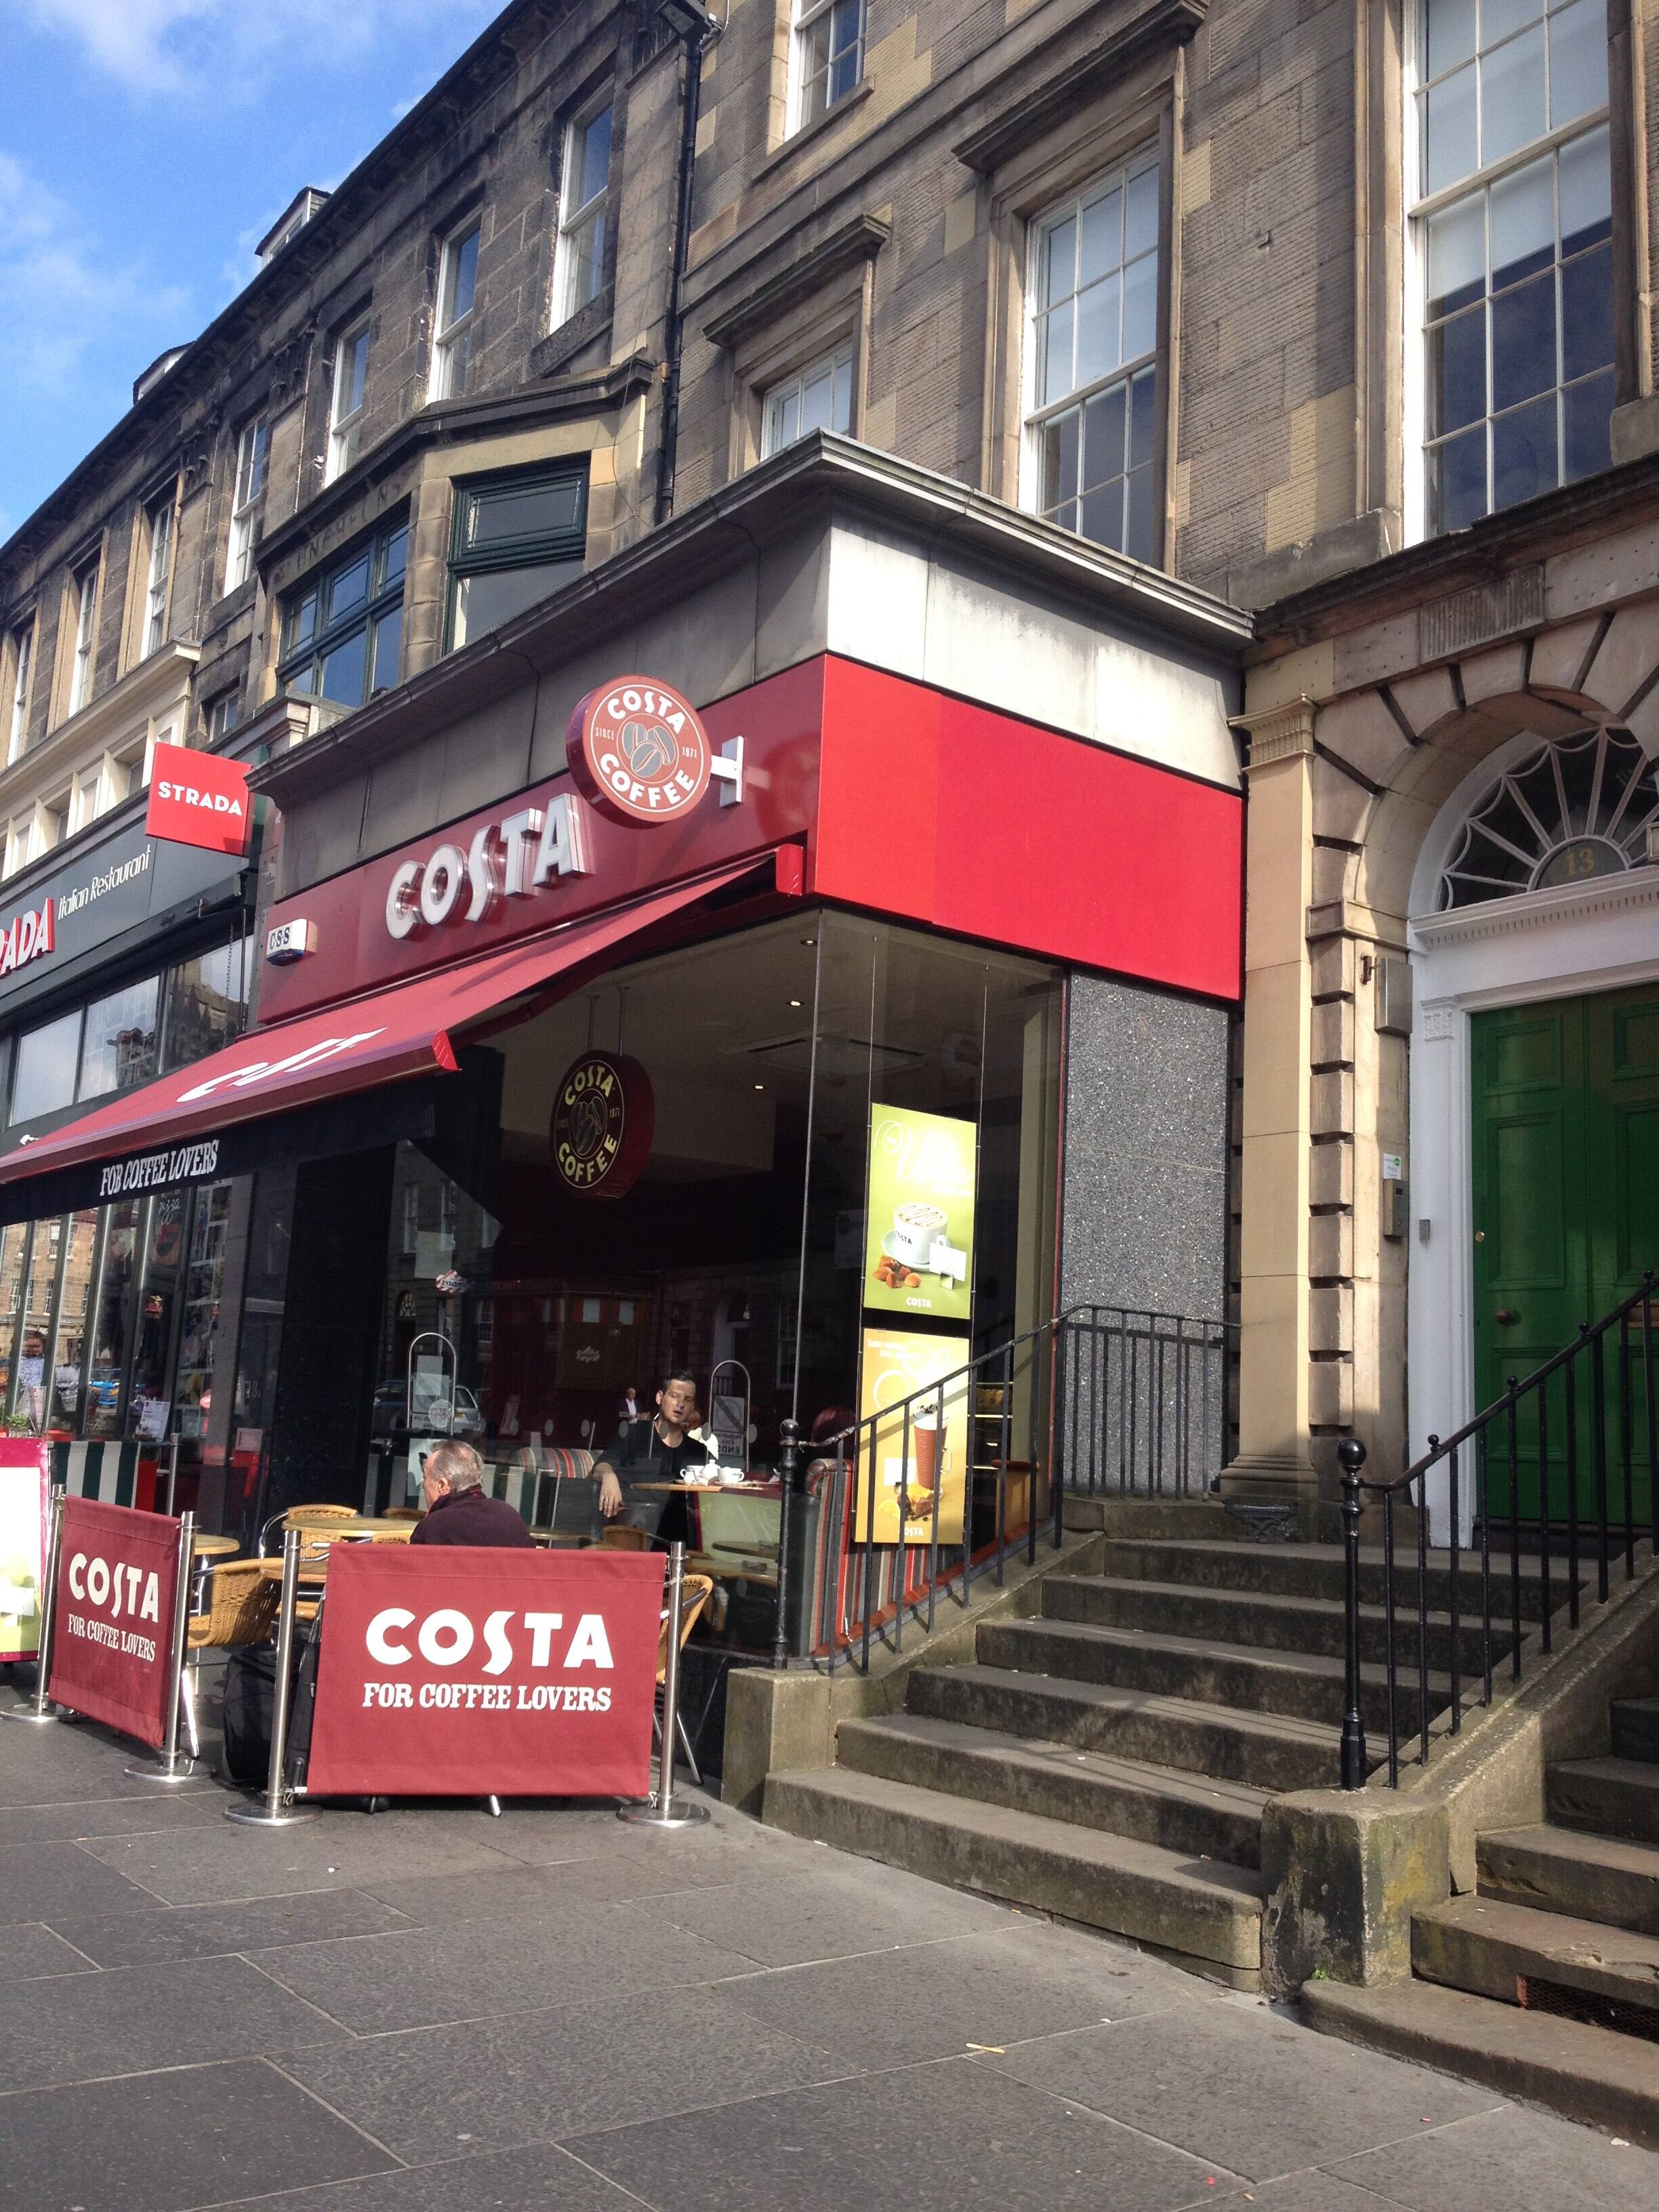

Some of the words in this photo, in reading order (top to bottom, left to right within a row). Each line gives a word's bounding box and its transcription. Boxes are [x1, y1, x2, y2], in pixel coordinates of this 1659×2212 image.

[595, 727, 615, 739] SINCE
[607, 690, 689, 735] COSTA
[681, 747, 698, 758] 1971
[157, 781, 243, 817] STRADA
[600, 753, 695, 807] COFFEE
[58, 888, 89, 920] Italian
[90, 844, 151, 901] Restaurant
[386, 793, 586, 939] COSTA
[1566, 848, 1595, 878] 13
[564, 1065, 613, 1106] COSTA
[100, 1165, 123, 1196] FOR
[123, 1153, 169, 1191] COFFEE
[169, 1139, 220, 1181] LOVERS
[558, 1133, 617, 1183] COFFEE
[905, 1296, 932, 1308] COSTA
[903, 1528, 923, 1537] OSTA
[69, 1553, 158, 1624] COSTA
[67, 1613, 86, 1637] FOR
[86, 1618, 119, 1650] COFFEE
[121, 1631, 157, 1662] LOVERS
[365, 1608, 615, 1675] COSTA
[363, 1683, 413, 1708] FOR
[419, 1684, 514, 1710] COFFEE
[517, 1685, 612, 1712] LOVERS
